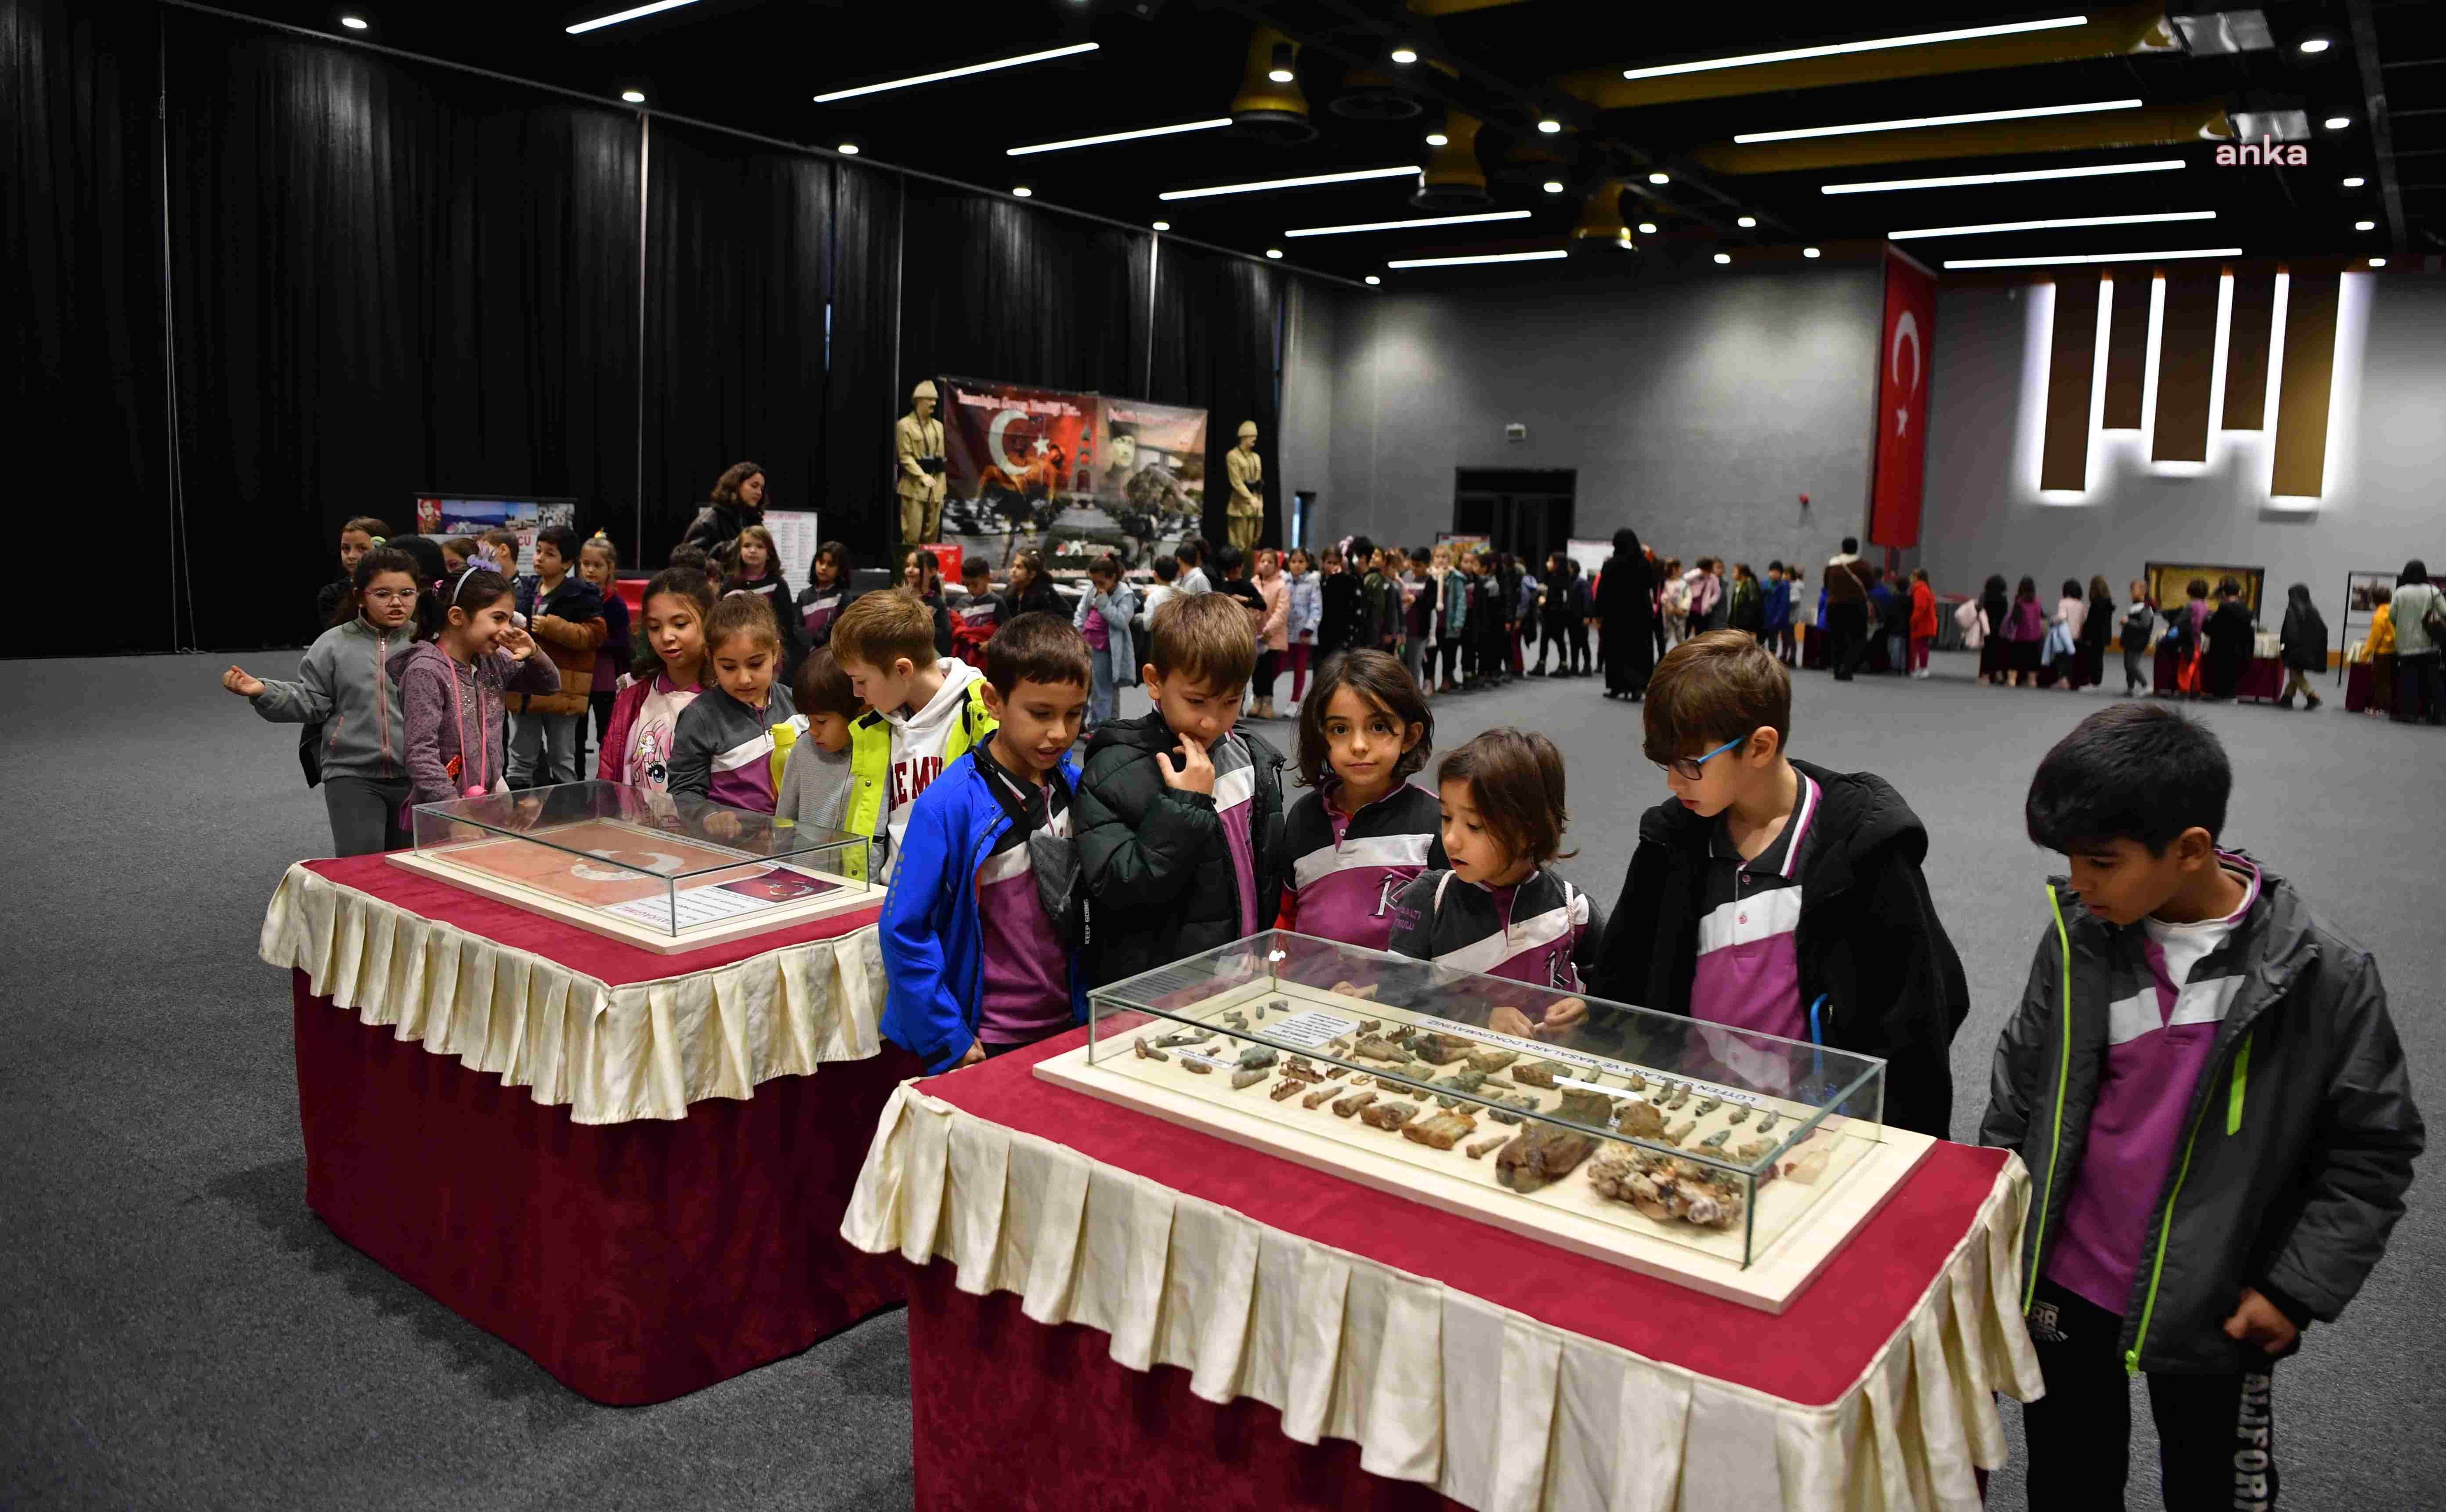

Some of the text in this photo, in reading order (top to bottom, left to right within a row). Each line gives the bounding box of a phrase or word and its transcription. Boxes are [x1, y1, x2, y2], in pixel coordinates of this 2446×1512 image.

[1426, 1018, 1522, 1046] DOKUNMAYINIZ
[1526, 1043, 1597, 1064] MASALARA
[1697, 1084, 1756, 1102] LÜTFEN
